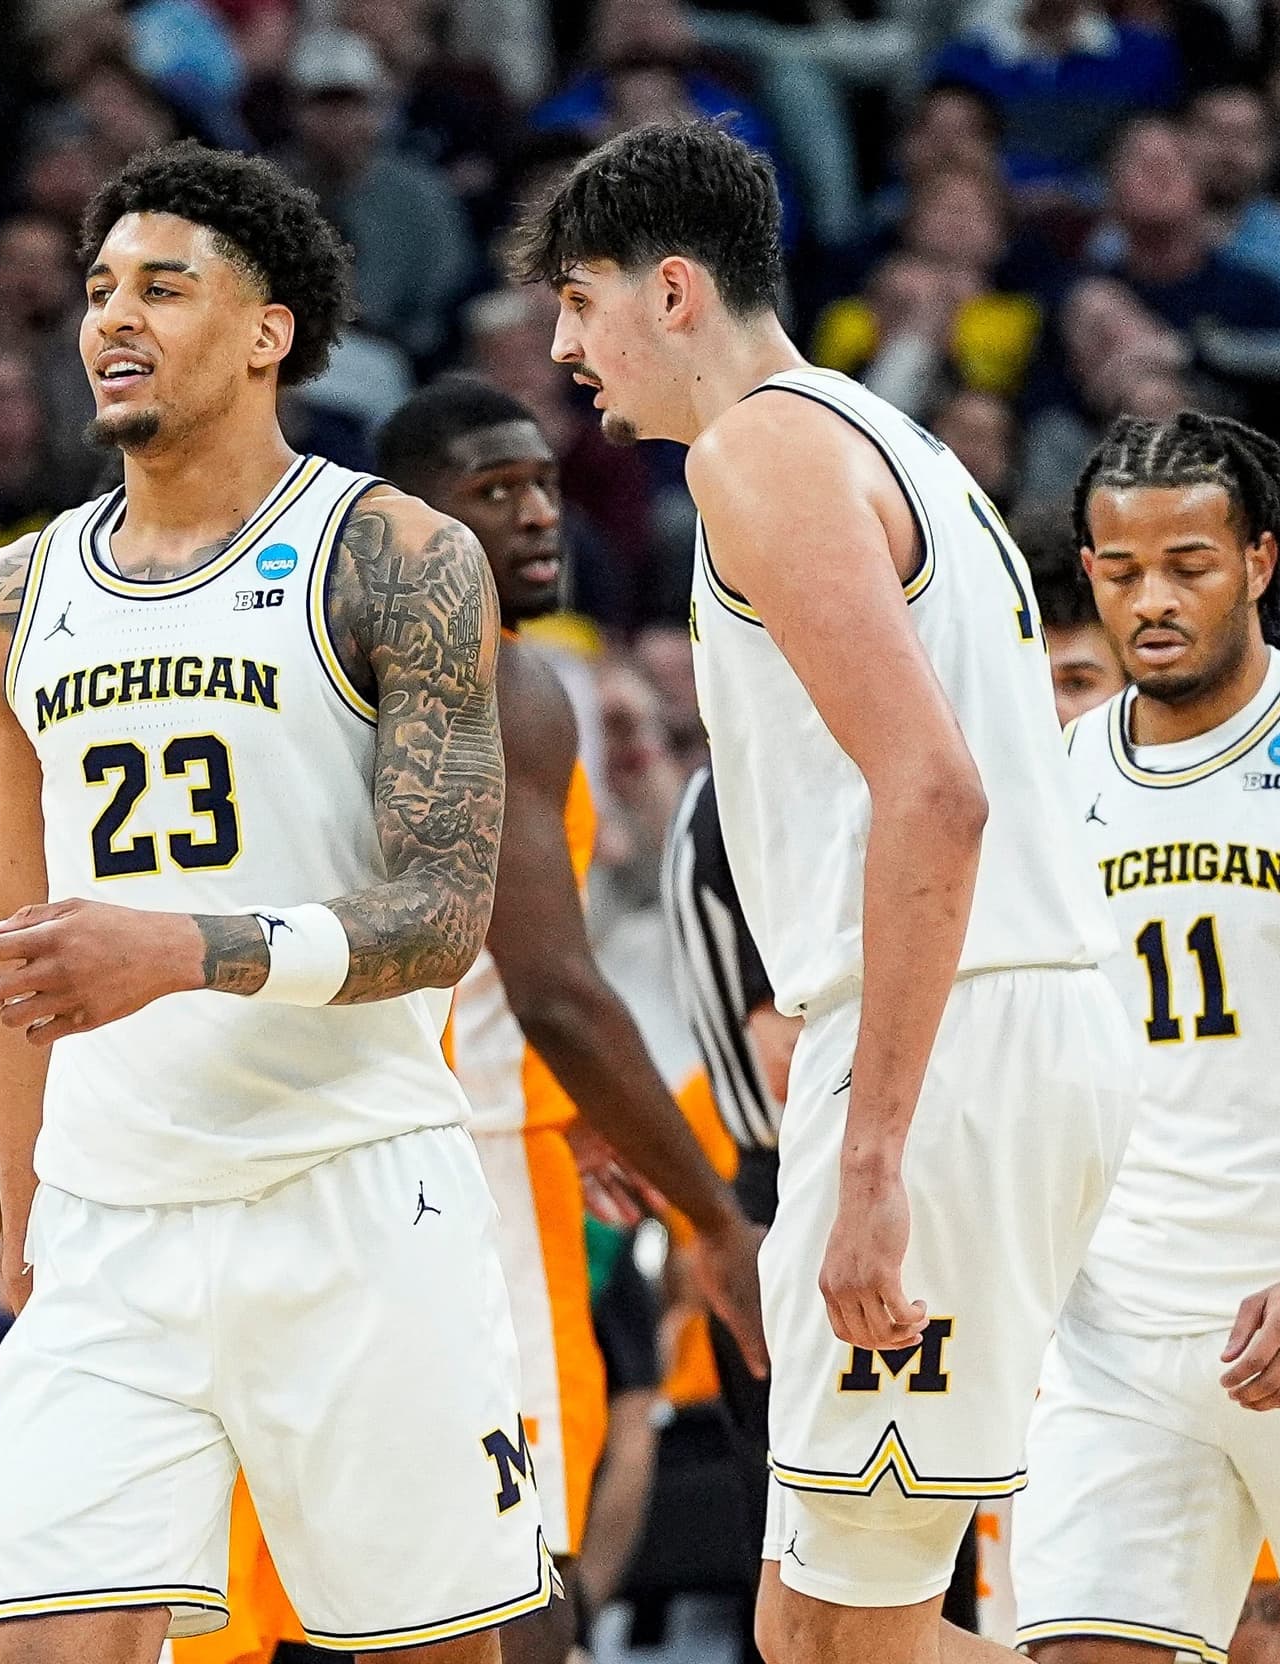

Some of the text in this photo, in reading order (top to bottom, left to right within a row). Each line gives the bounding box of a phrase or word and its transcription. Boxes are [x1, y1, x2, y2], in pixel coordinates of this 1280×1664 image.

[35, 655, 281, 734] MICHIGAN
[83, 731, 242, 881] 23
[1135, 913, 1240, 1043] 11
[838, 1315, 955, 1393] M
[480, 1412, 537, 1516] M
